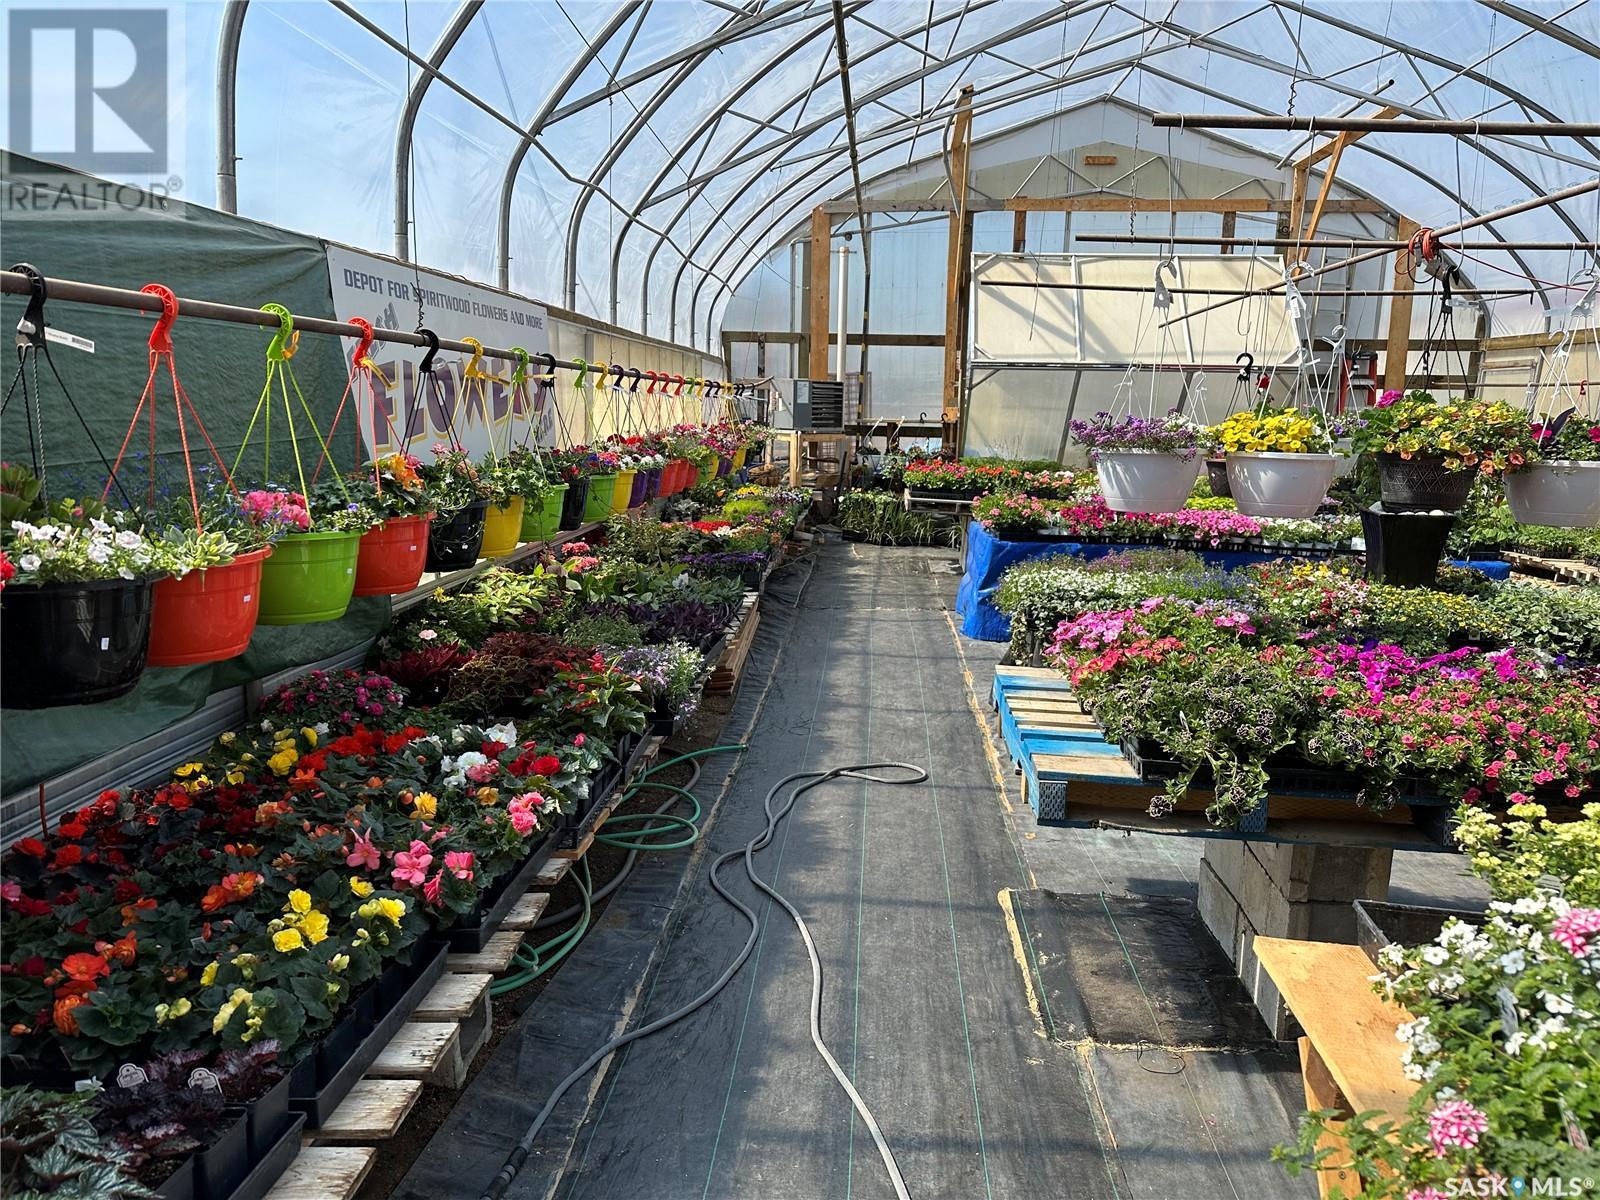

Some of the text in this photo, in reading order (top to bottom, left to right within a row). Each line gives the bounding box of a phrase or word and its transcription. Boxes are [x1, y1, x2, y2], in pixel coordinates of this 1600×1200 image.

[343, 268, 544, 330] DEPOT FOR SPIRITWOOD FLOWERS AND MORE
